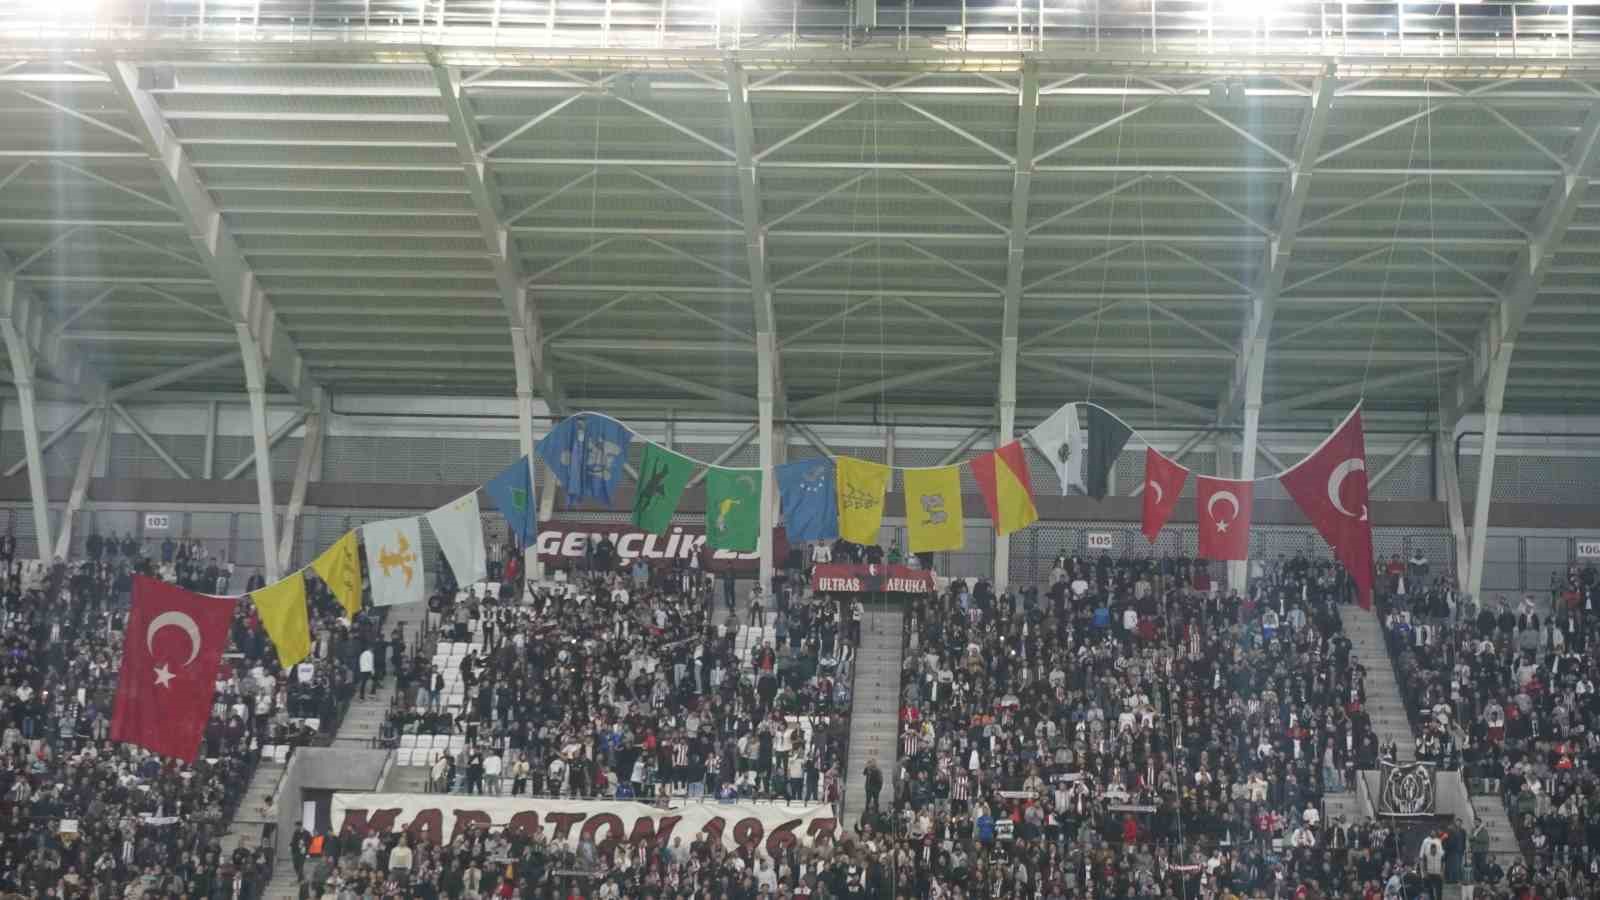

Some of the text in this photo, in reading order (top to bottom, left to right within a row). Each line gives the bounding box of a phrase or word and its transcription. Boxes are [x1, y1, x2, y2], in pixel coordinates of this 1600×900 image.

[148, 517, 168, 527] 103
[1089, 535, 1111, 546] 105
[819, 577, 861, 592] ULTRAS
